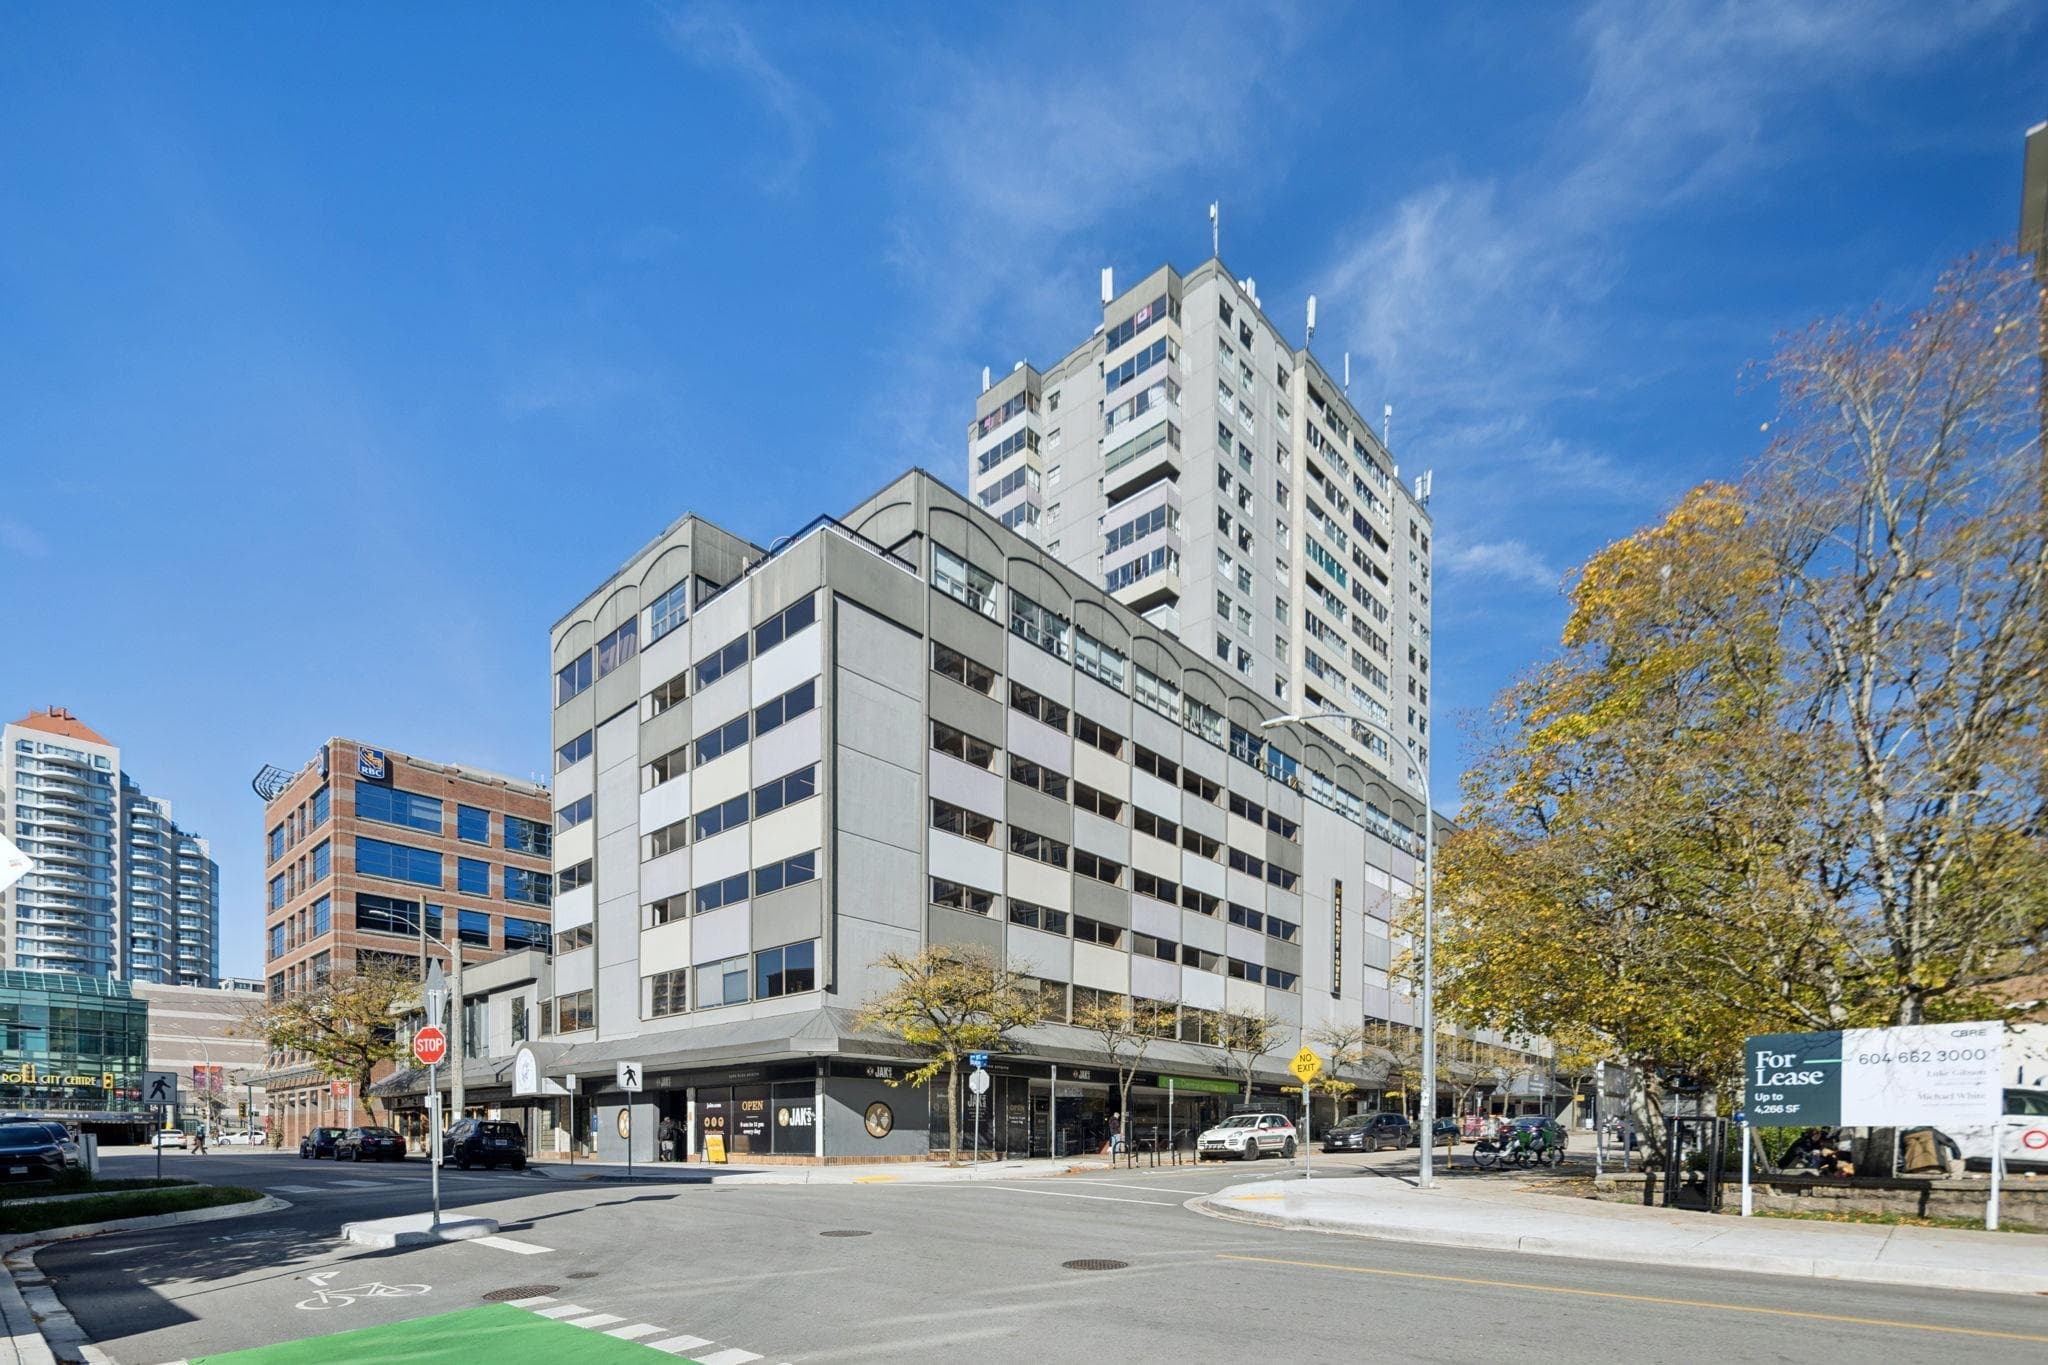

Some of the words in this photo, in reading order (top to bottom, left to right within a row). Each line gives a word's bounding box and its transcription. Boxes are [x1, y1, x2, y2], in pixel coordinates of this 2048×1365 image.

[361, 766, 382, 777] RBC
[1951, 1029, 1987, 1037] CBRE
[416, 1038, 443, 1052] STOP
[1299, 1053, 1312, 1062] NO
[1755, 1050, 1797, 1068] For
[1858, 1053, 1892, 1065] 604
[1937, 1048, 1987, 1062] 3000
[1297, 1063, 1315, 1072] EXIT
[40, 1074, 61, 1085] CITY
[64, 1076, 97, 1086] CENTRE
[1755, 1068, 1824, 1087] Lease
[1754, 1093, 1770, 1102] Up
[1772, 1093, 1784, 1101] to
[742, 1100, 763, 1110] OPEN
[1785, 1103, 1800, 1113] SF
